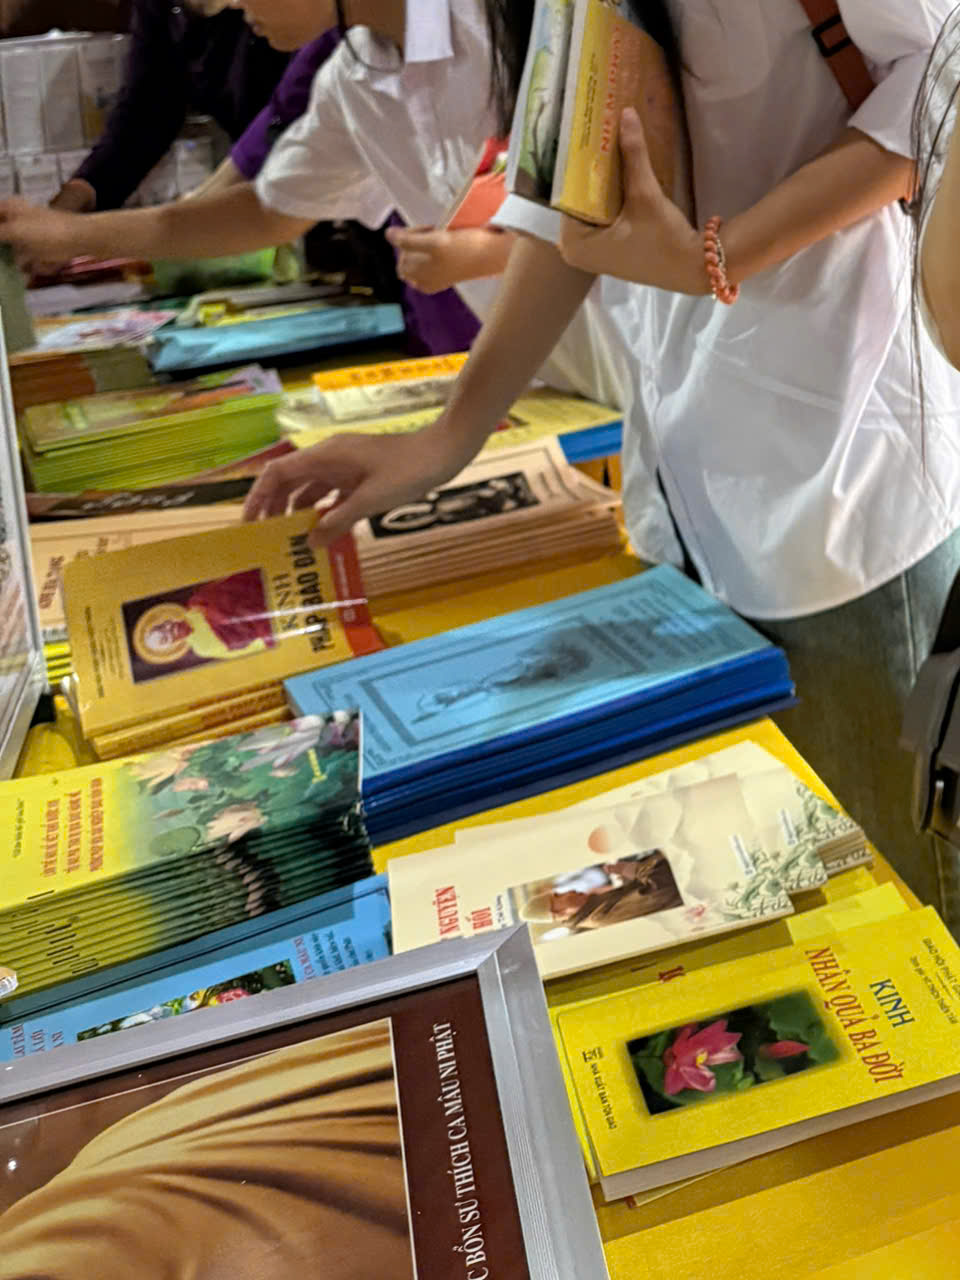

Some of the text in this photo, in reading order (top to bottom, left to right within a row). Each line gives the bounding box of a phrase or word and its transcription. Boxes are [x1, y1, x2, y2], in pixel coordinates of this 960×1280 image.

[432, 885, 460, 936] NGUYỆN
[805, 946, 905, 1084] NHÂN QUẢ BA ĐỜI
[869, 978, 915, 1028] KINH
[429, 1022, 457, 1064] PHẬT
[438, 1061, 459, 1080] NI
[437, 1079, 465, 1113] MÂU
[447, 1112, 469, 1141] CA
[447, 1140, 476, 1199] THÍCH
[454, 1199, 480, 1223] SƯ
[453, 1228, 487, 1267] BỔN
